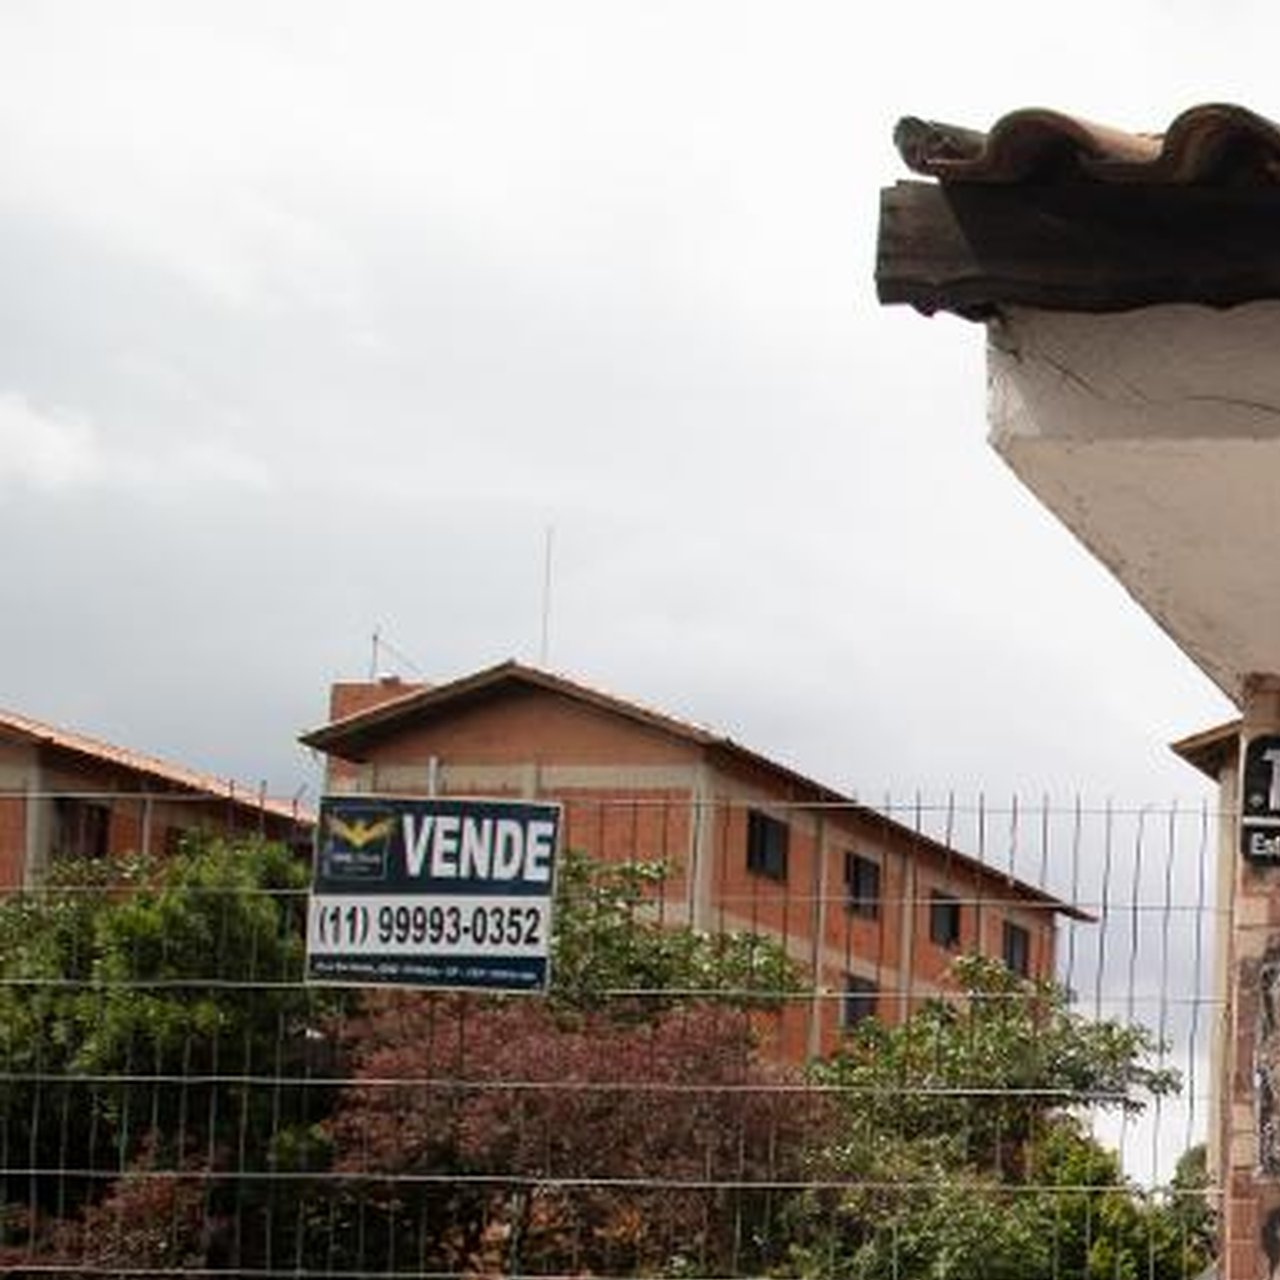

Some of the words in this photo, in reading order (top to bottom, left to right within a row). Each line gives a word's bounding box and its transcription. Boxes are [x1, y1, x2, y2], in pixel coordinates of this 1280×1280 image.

[403, 814, 556, 881] VENDE
[319, 906, 369, 946] (11)
[377, 906, 541, 946] 99993-0352
